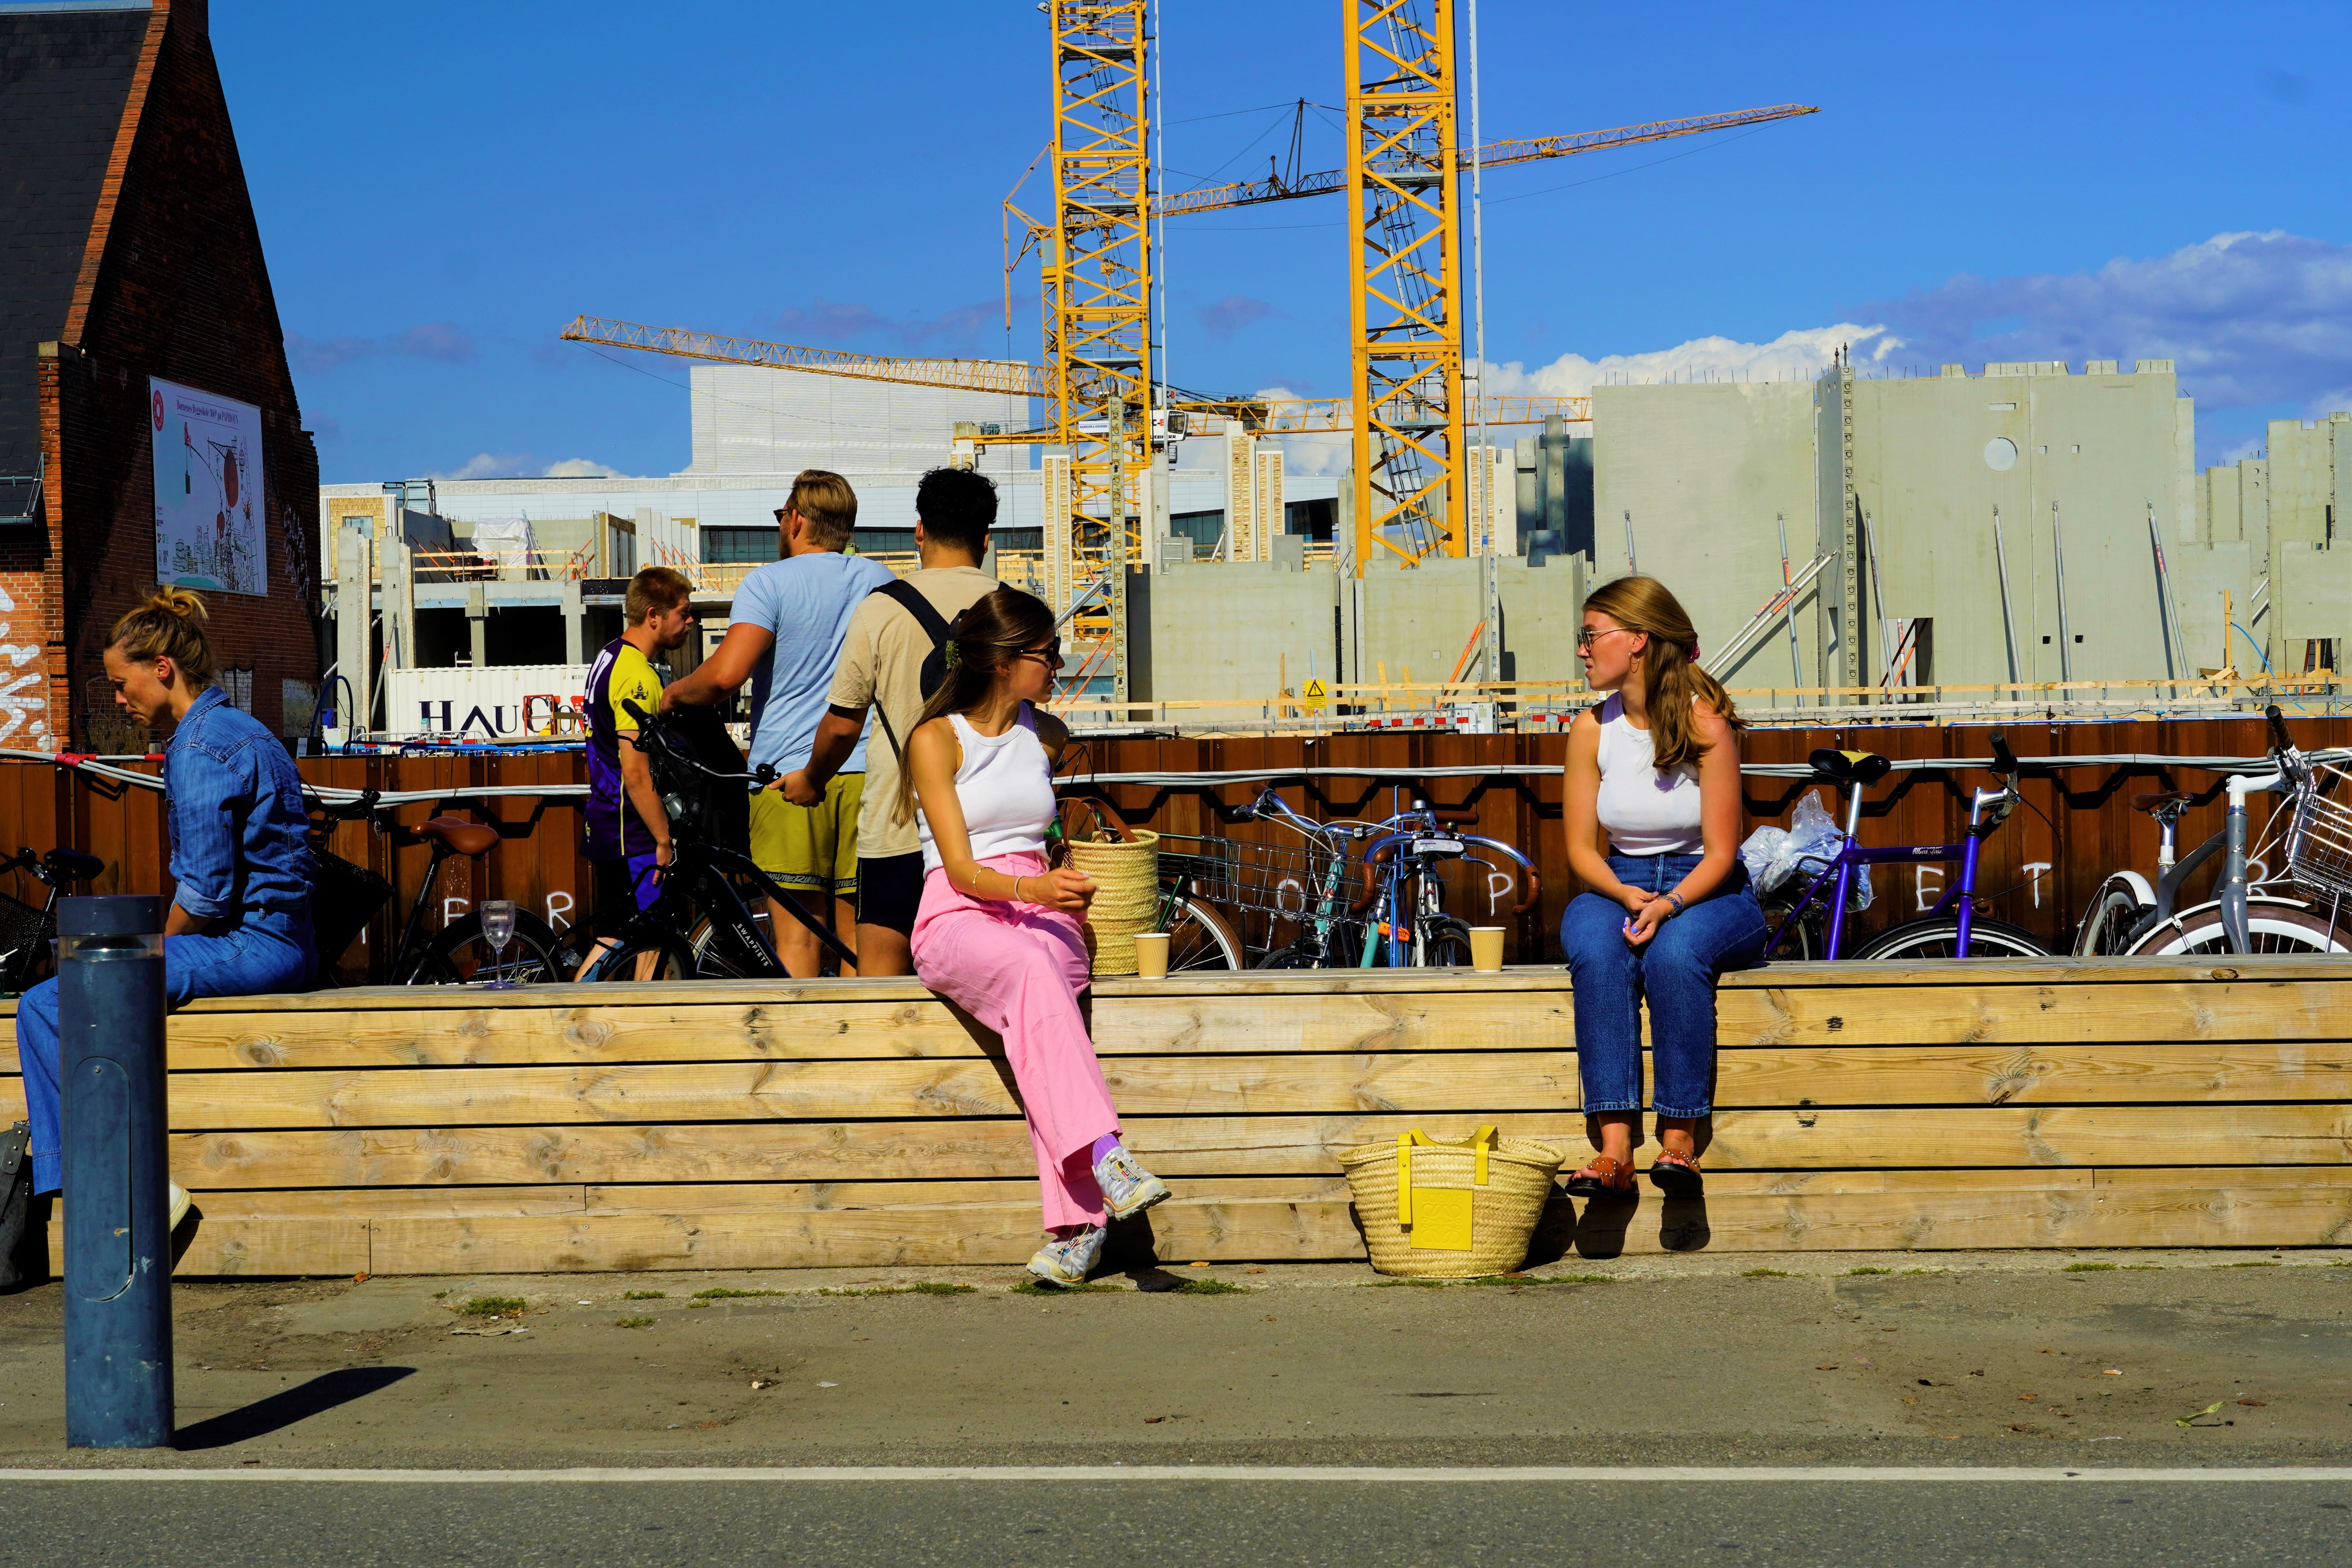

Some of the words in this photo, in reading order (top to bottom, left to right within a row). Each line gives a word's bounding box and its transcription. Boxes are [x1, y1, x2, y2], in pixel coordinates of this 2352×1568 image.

[547, 891, 573, 929] R
[1487, 872, 1514, 916] P
[1916, 865, 1944, 911] E
[2022, 862, 2052, 909] T
[737, 924, 769, 966] SWAPFIETS
[1421, 1192, 1463, 1205] LOEWE
